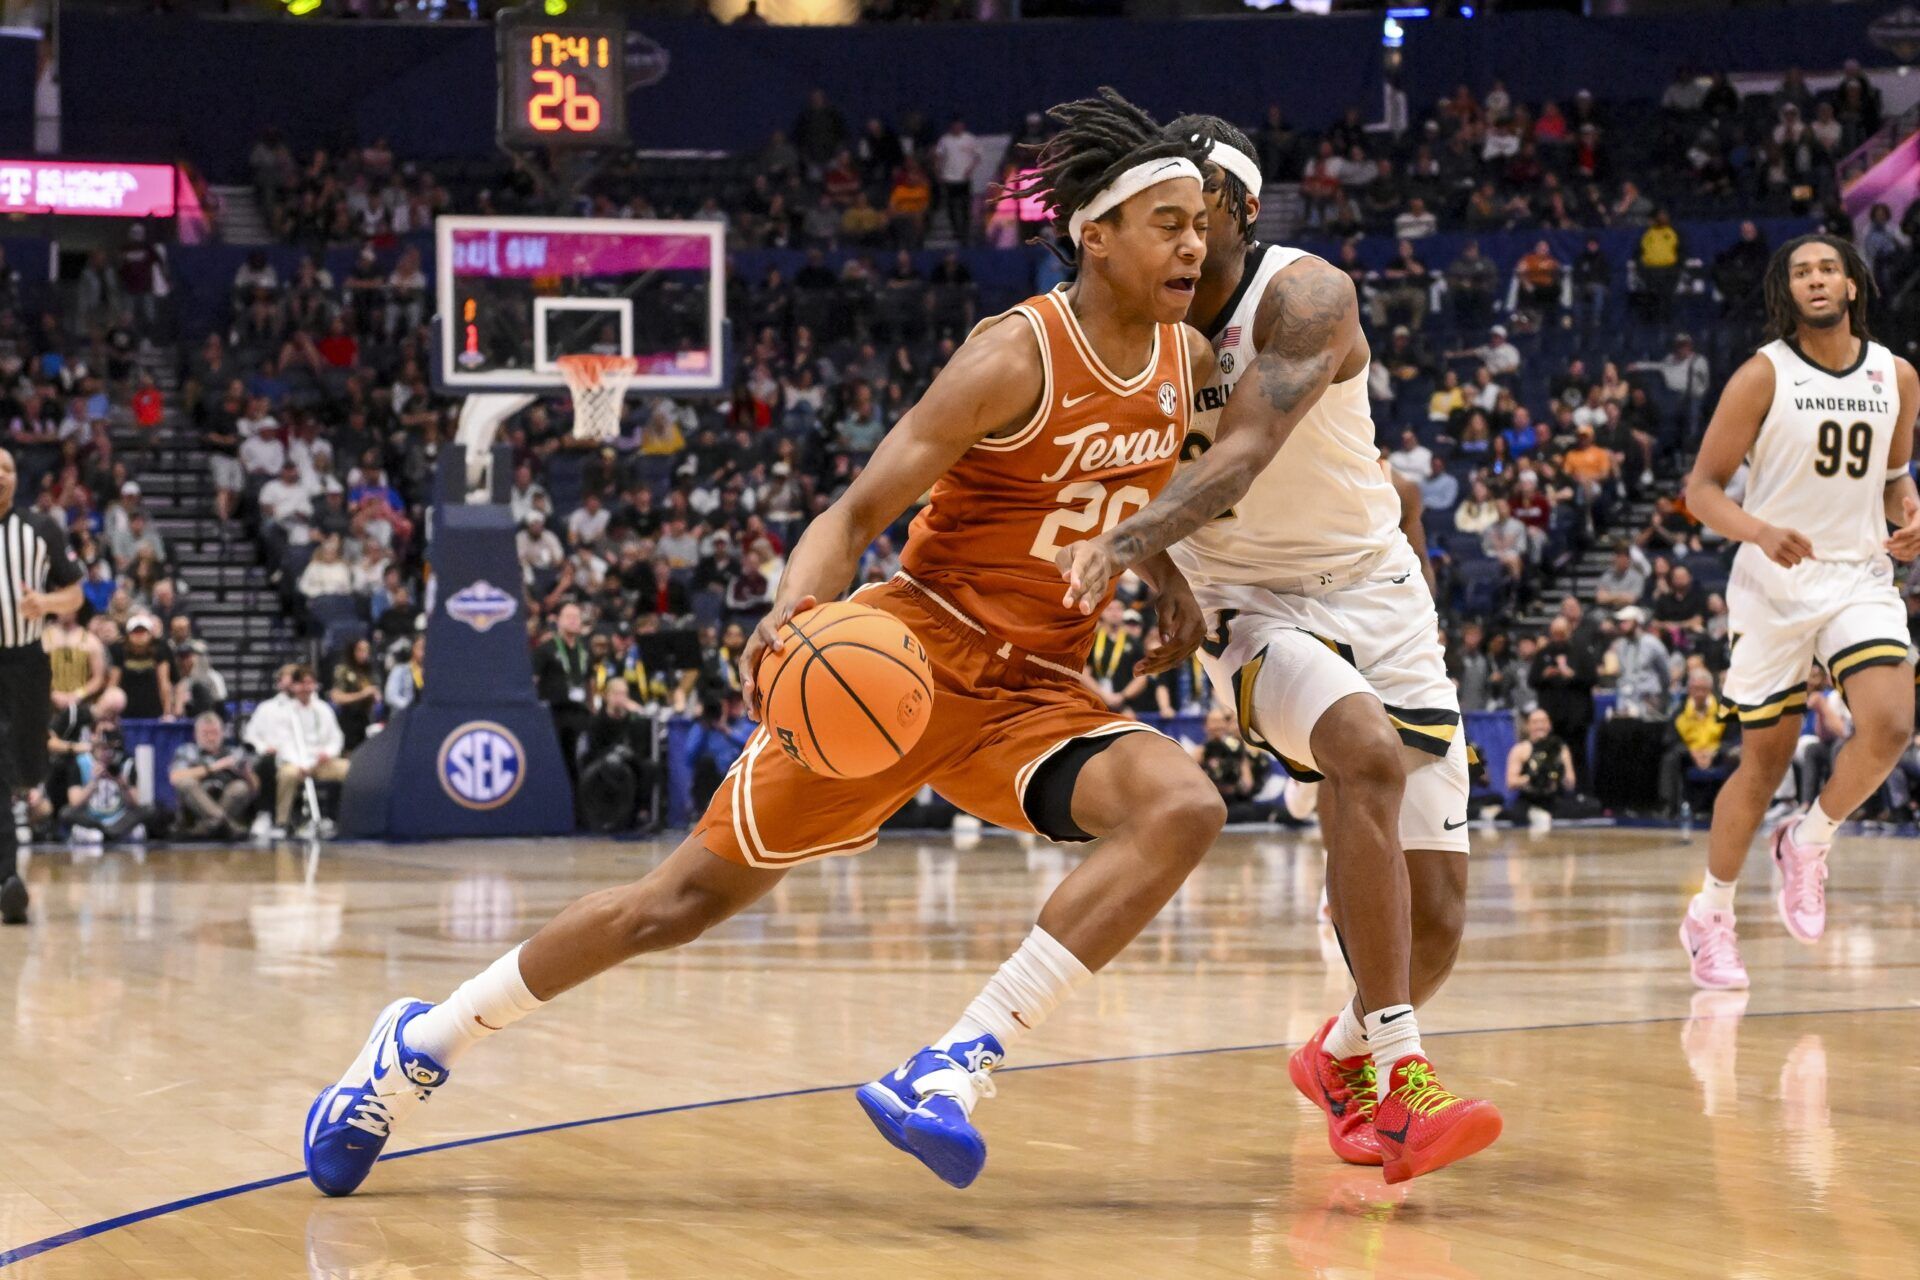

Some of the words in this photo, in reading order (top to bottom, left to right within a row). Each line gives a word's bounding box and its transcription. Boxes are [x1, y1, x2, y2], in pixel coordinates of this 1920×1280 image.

[531, 33, 609, 68] 17:41
[529, 70, 600, 131] 26
[1159, 383, 1177, 415] SEC
[1794, 398, 1888, 414] VANDERBILT
[1041, 422, 1179, 482] Texas
[1815, 420, 1873, 479] 99
[1029, 481, 1150, 563] 20
[446, 730, 516, 800] SEC
